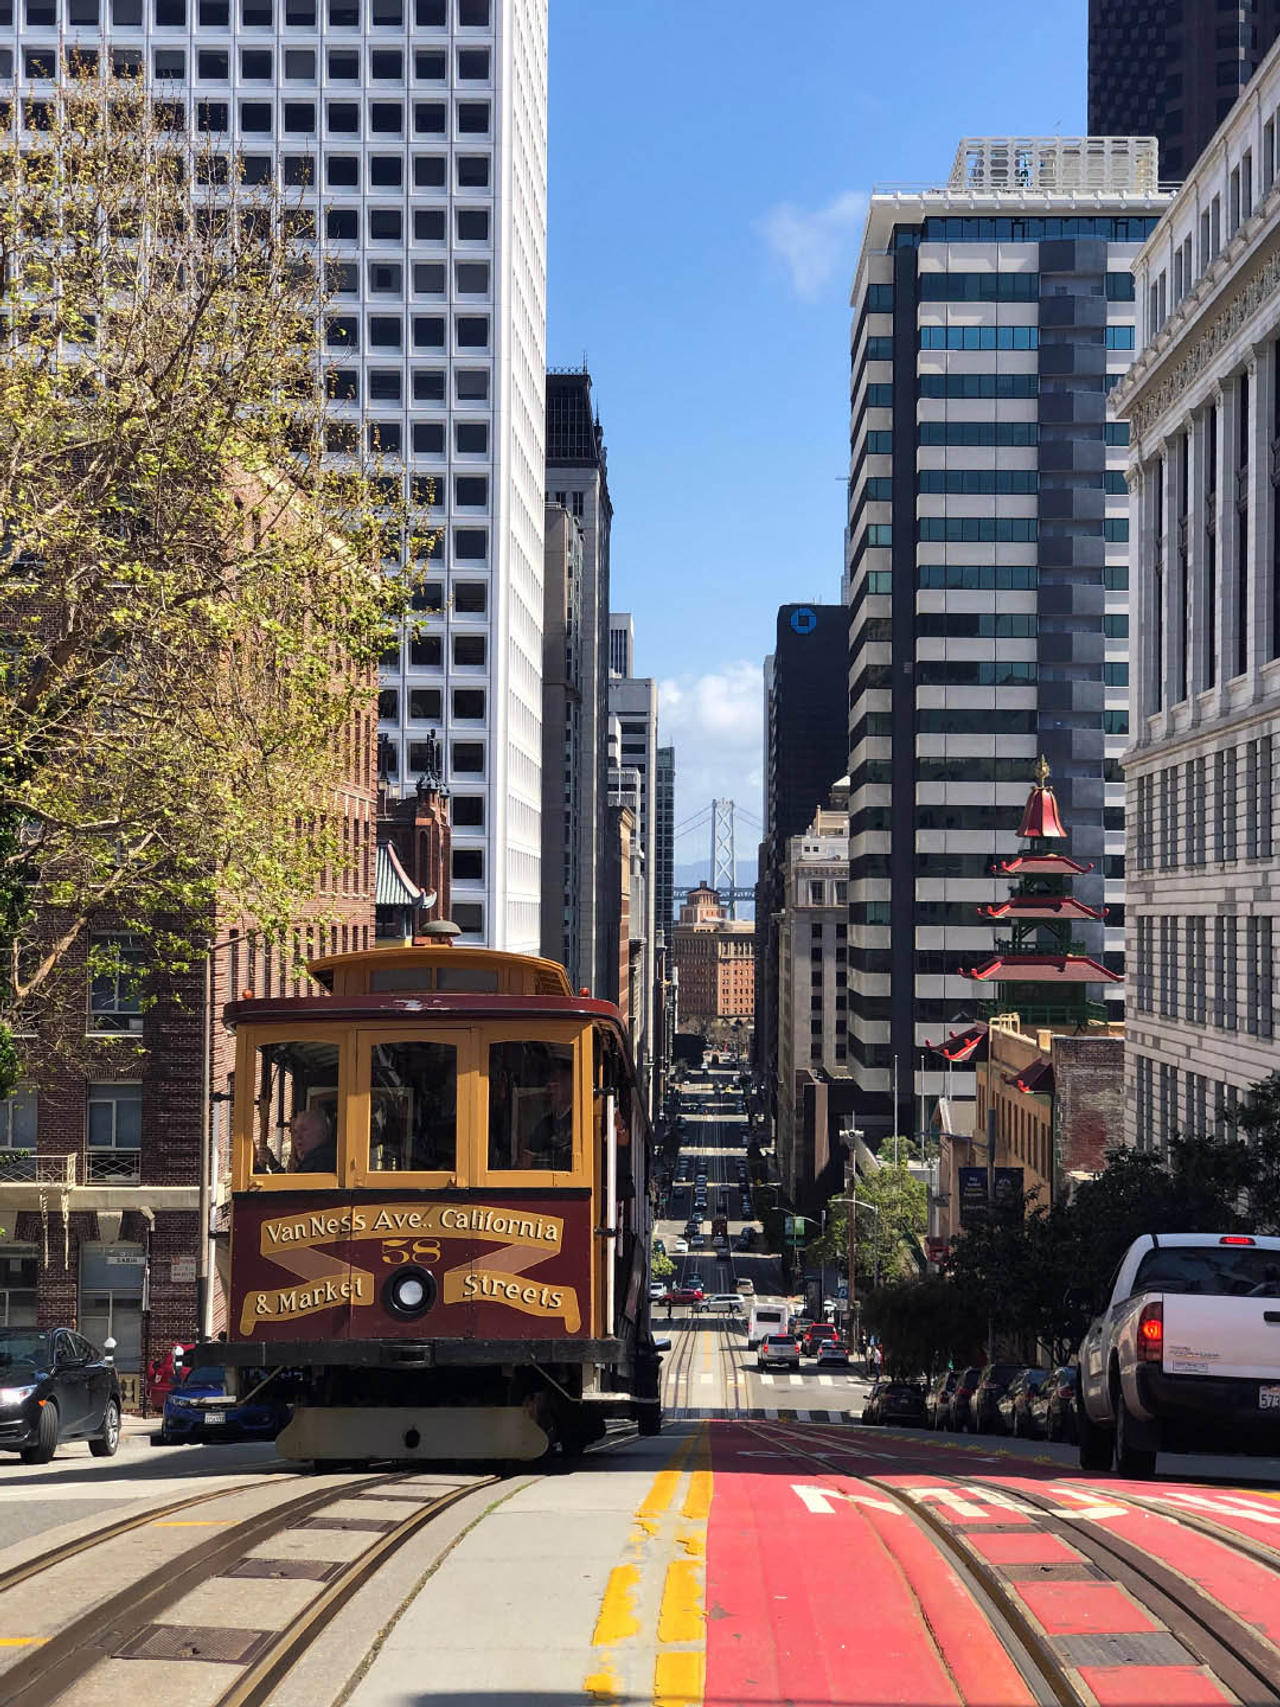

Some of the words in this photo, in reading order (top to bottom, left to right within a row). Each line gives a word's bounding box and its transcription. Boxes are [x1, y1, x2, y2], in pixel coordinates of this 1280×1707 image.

[266, 1222, 306, 1243] Van
[310, 1211, 366, 1237] Ness
[440, 1208, 558, 1241] California
[382, 1239, 441, 1264] 58
[256, 1293, 272, 1314] &
[276, 1277, 362, 1314] Market
[463, 1274, 564, 1309] Streets
